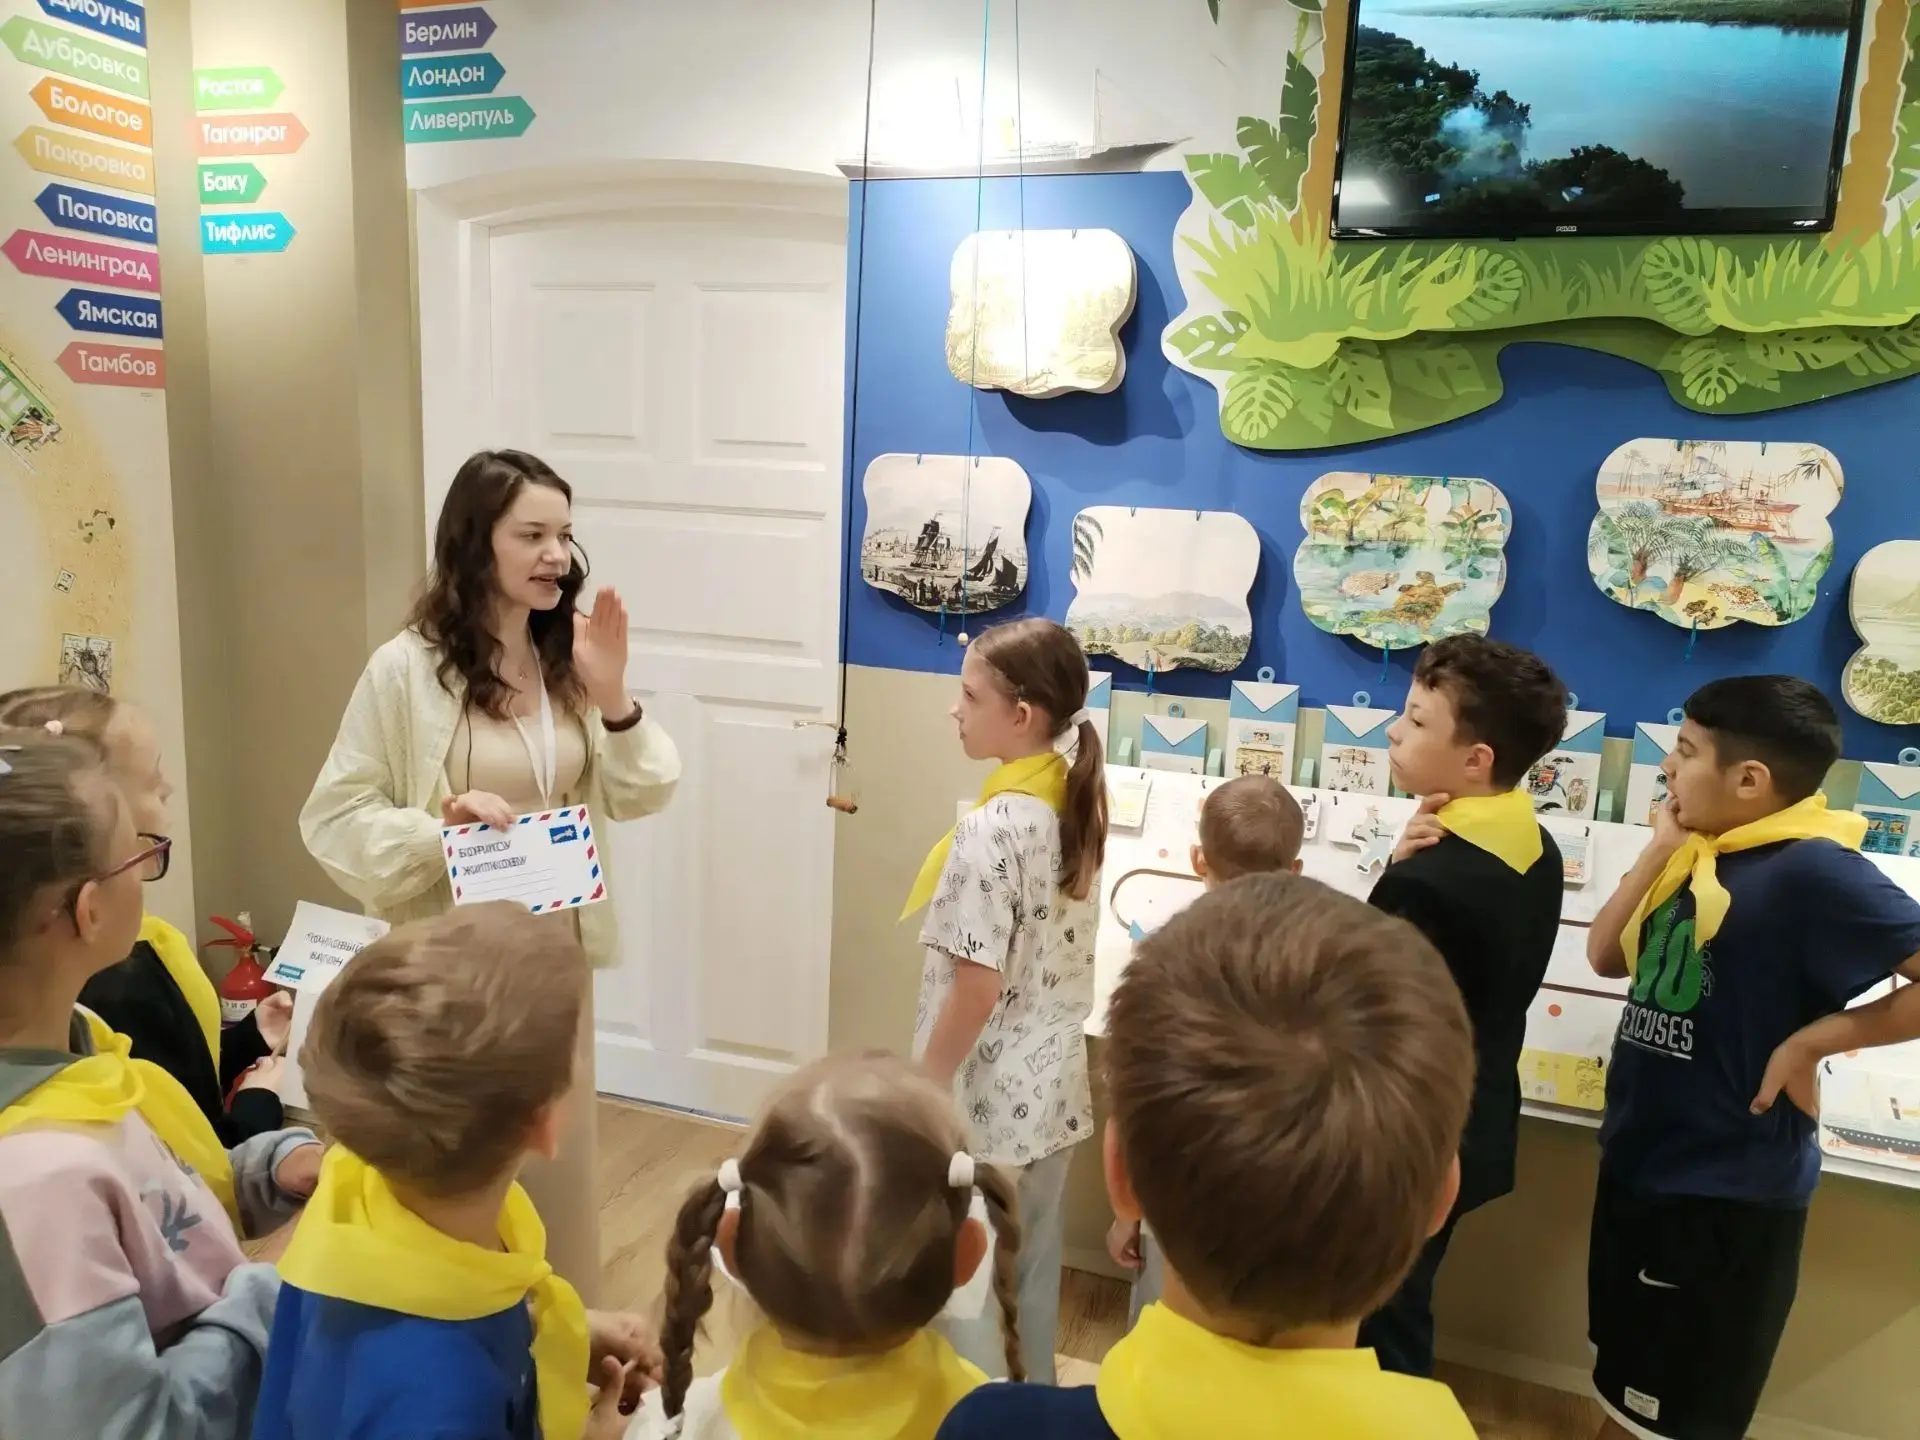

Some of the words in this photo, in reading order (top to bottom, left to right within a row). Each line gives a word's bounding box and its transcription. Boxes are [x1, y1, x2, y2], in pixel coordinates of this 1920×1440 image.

[405, 21, 478, 45] Берлин
[23, 28, 140, 84] Дубровка
[199, 77, 265, 97] Ростов
[408, 66, 485, 87] Лондон
[50, 86, 143, 131] Бологое
[410, 109, 514, 132] Ливерпуль
[202, 123, 287, 146] Таганрог
[35, 134, 146, 181] Покровка
[203, 171, 249, 194] Баку
[58, 194, 154, 233] Поповка
[205, 221, 276, 245] Тифлис
[25, 238, 152, 282] Ленинград
[78, 300, 158, 329] Ямская
[78, 350, 157, 376] Тамбов
[1622, 1003, 1694, 1052] EXCUSES
